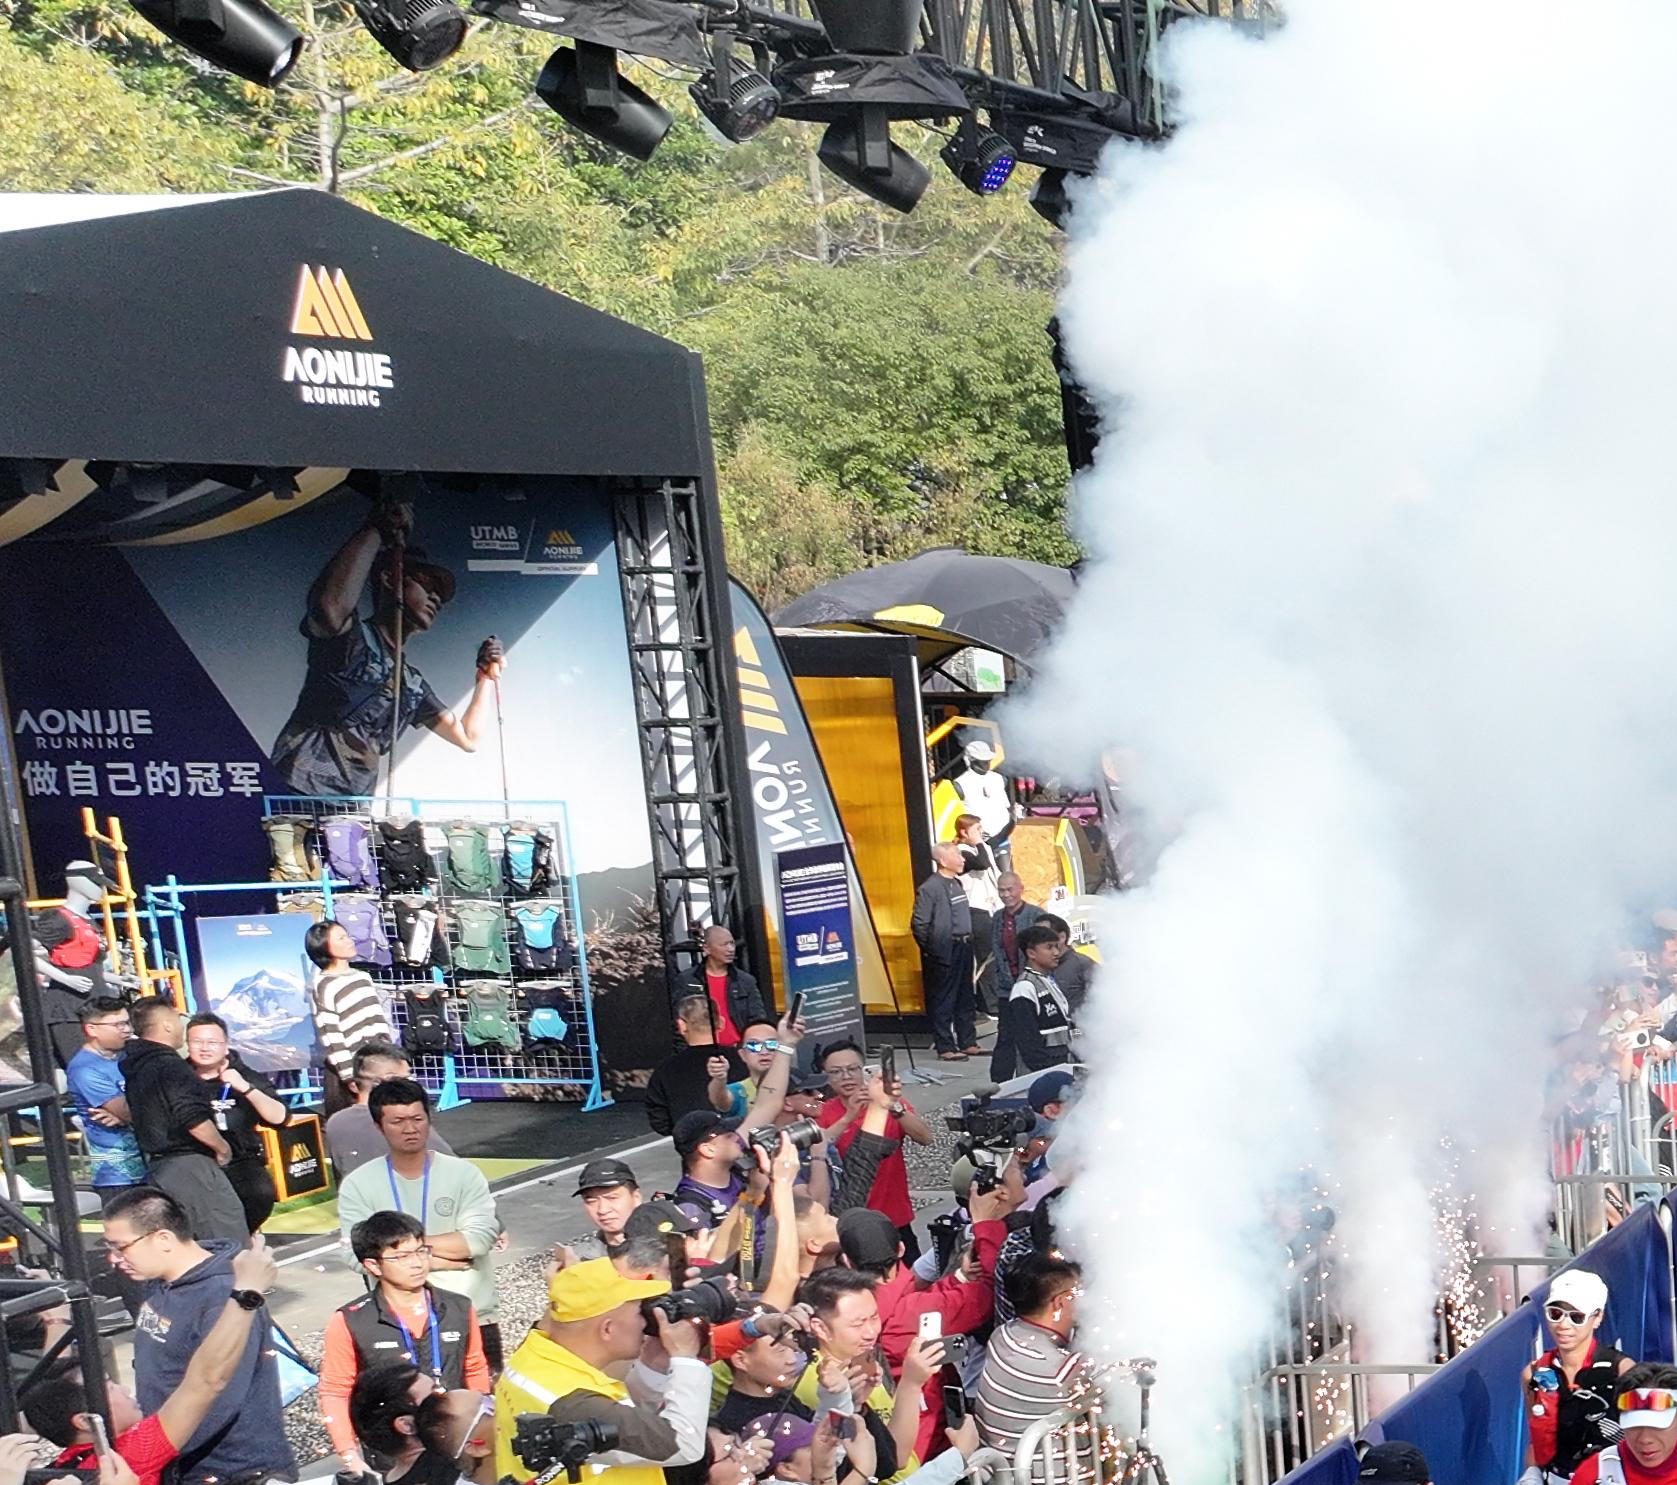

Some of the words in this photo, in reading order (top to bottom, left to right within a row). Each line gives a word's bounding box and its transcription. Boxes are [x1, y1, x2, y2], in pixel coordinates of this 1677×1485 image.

[284, 346, 394, 388] AONIJIE
[301, 385, 380, 408] RUNNING
[470, 525, 519, 540] UTMB
[15, 708, 154, 735] AONIJIE
[35, 736, 136, 750] RUNNING
[21, 760, 264, 798] 做自己的冠军
